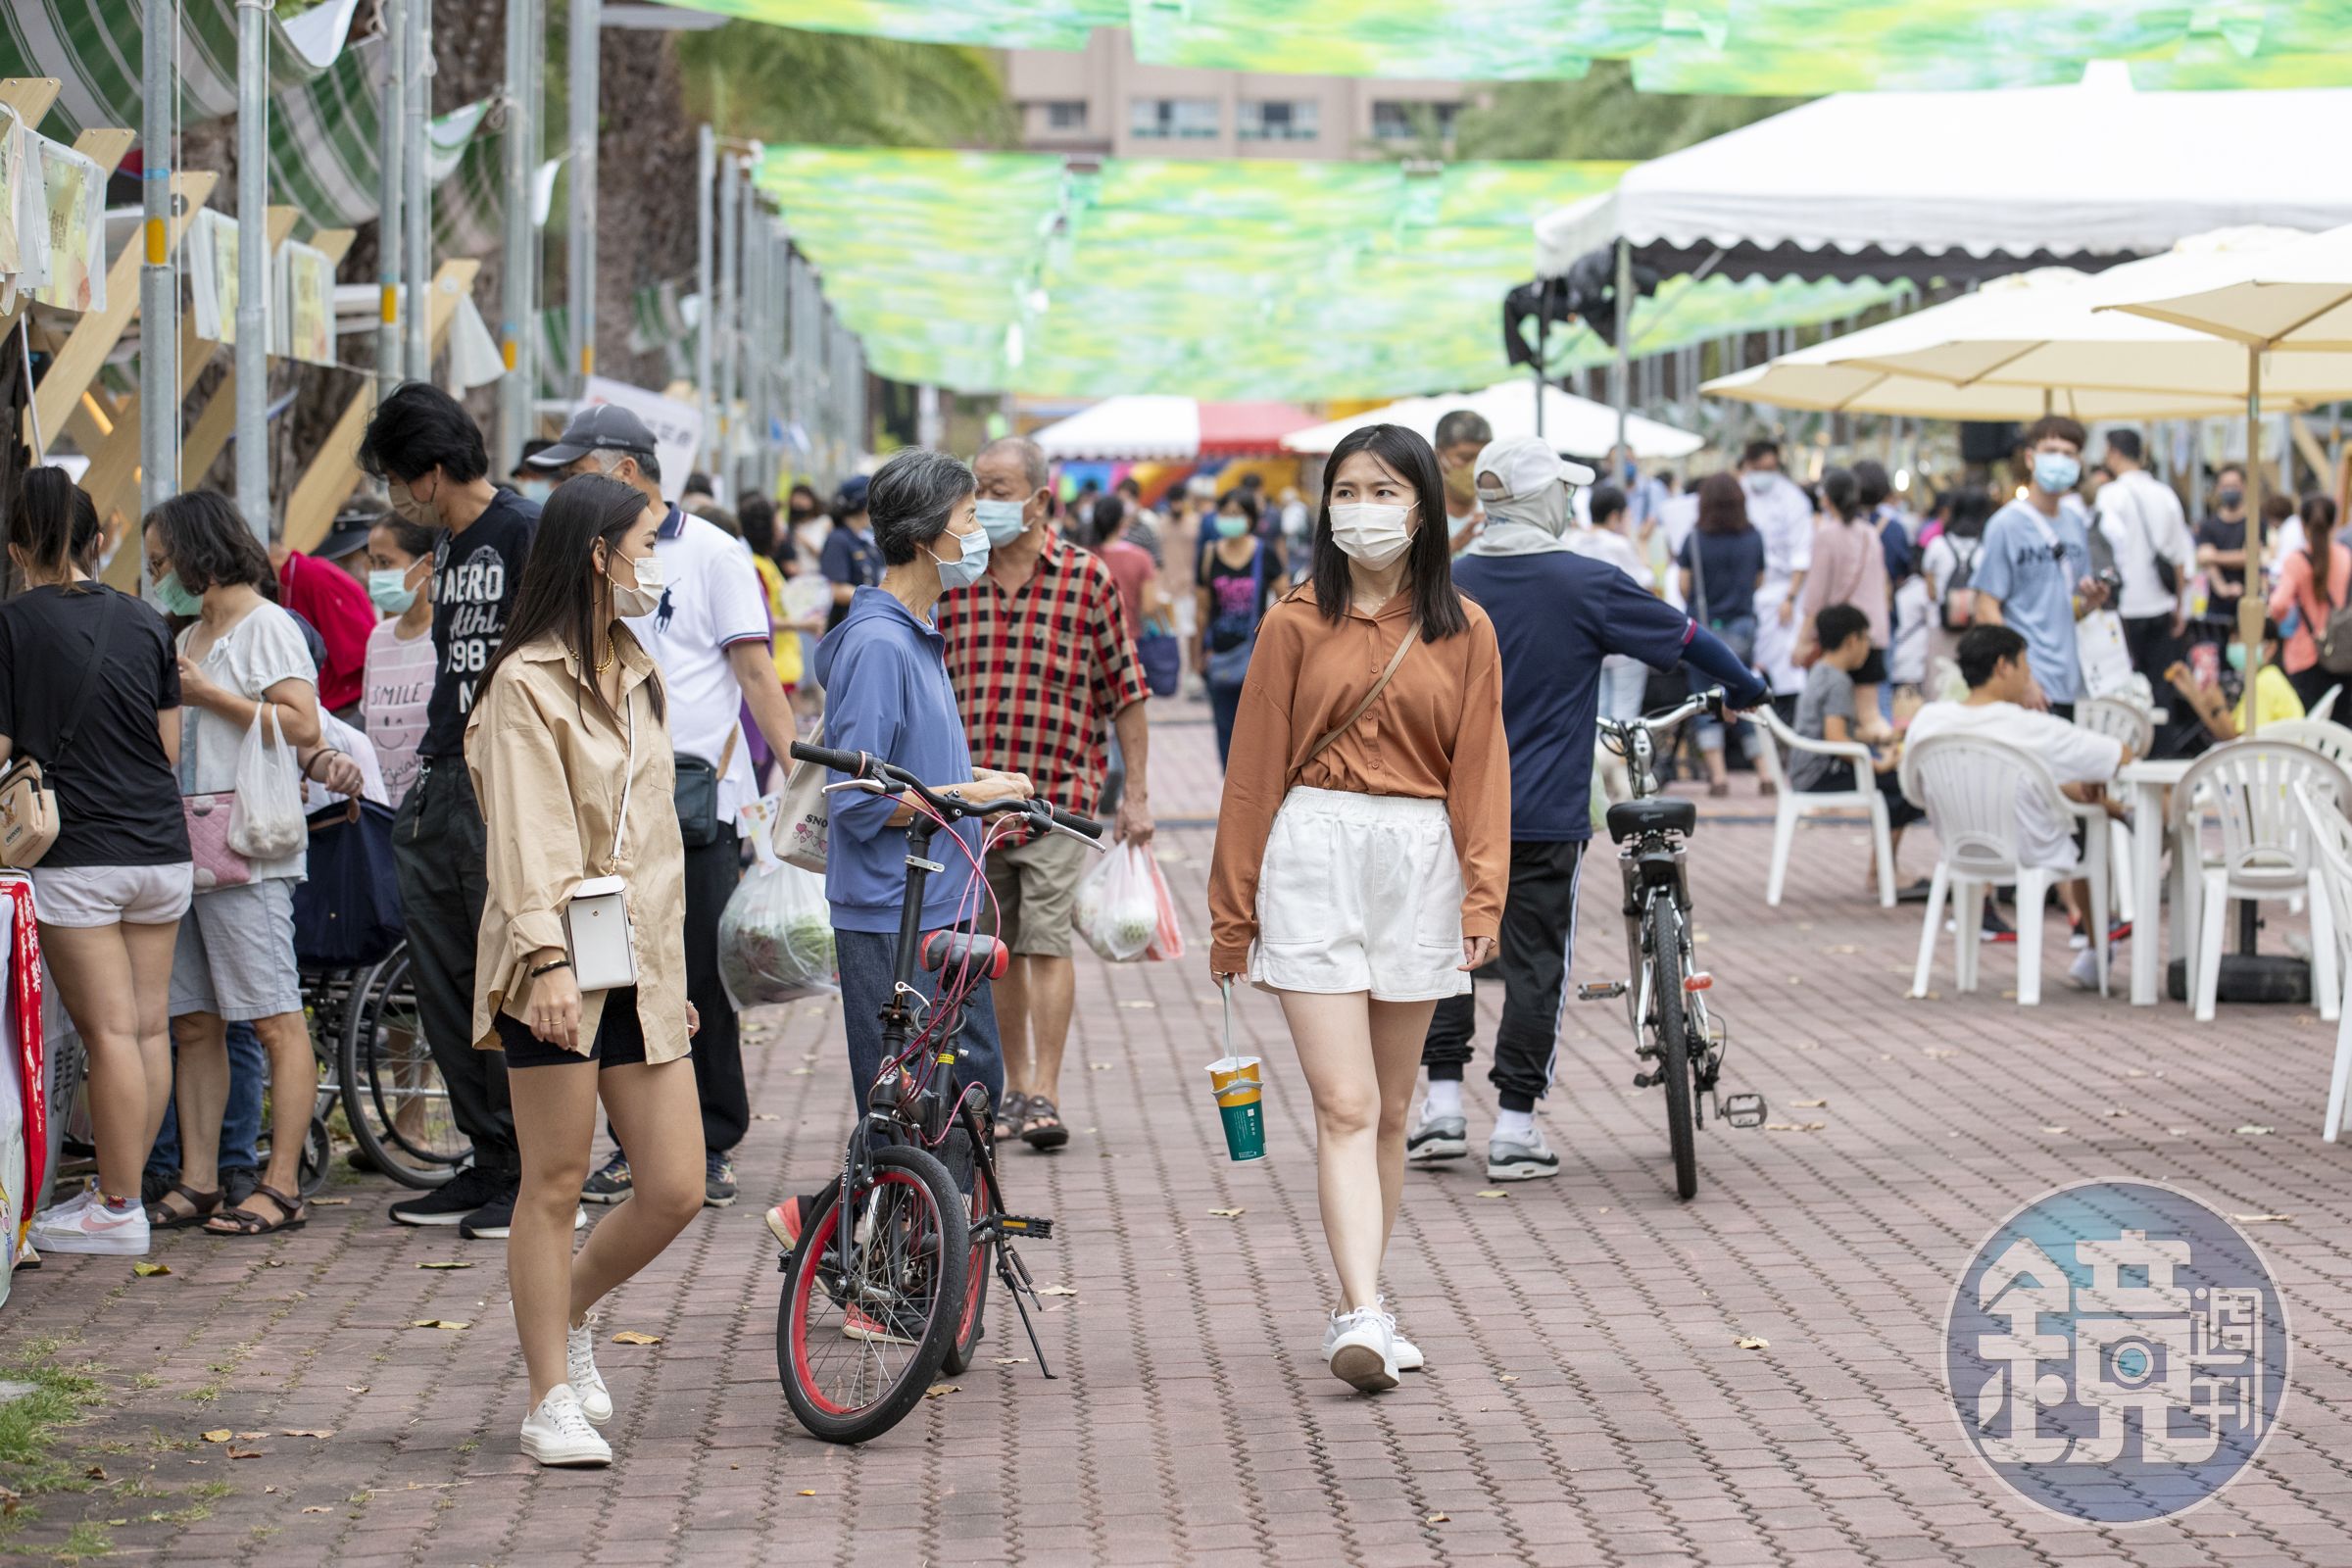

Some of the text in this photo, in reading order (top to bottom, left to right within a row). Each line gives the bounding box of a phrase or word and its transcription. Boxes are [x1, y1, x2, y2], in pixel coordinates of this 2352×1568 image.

[443, 564, 505, 605] AERO
[450, 604, 506, 639] Athl.
[370, 682, 423, 706] SMILE
